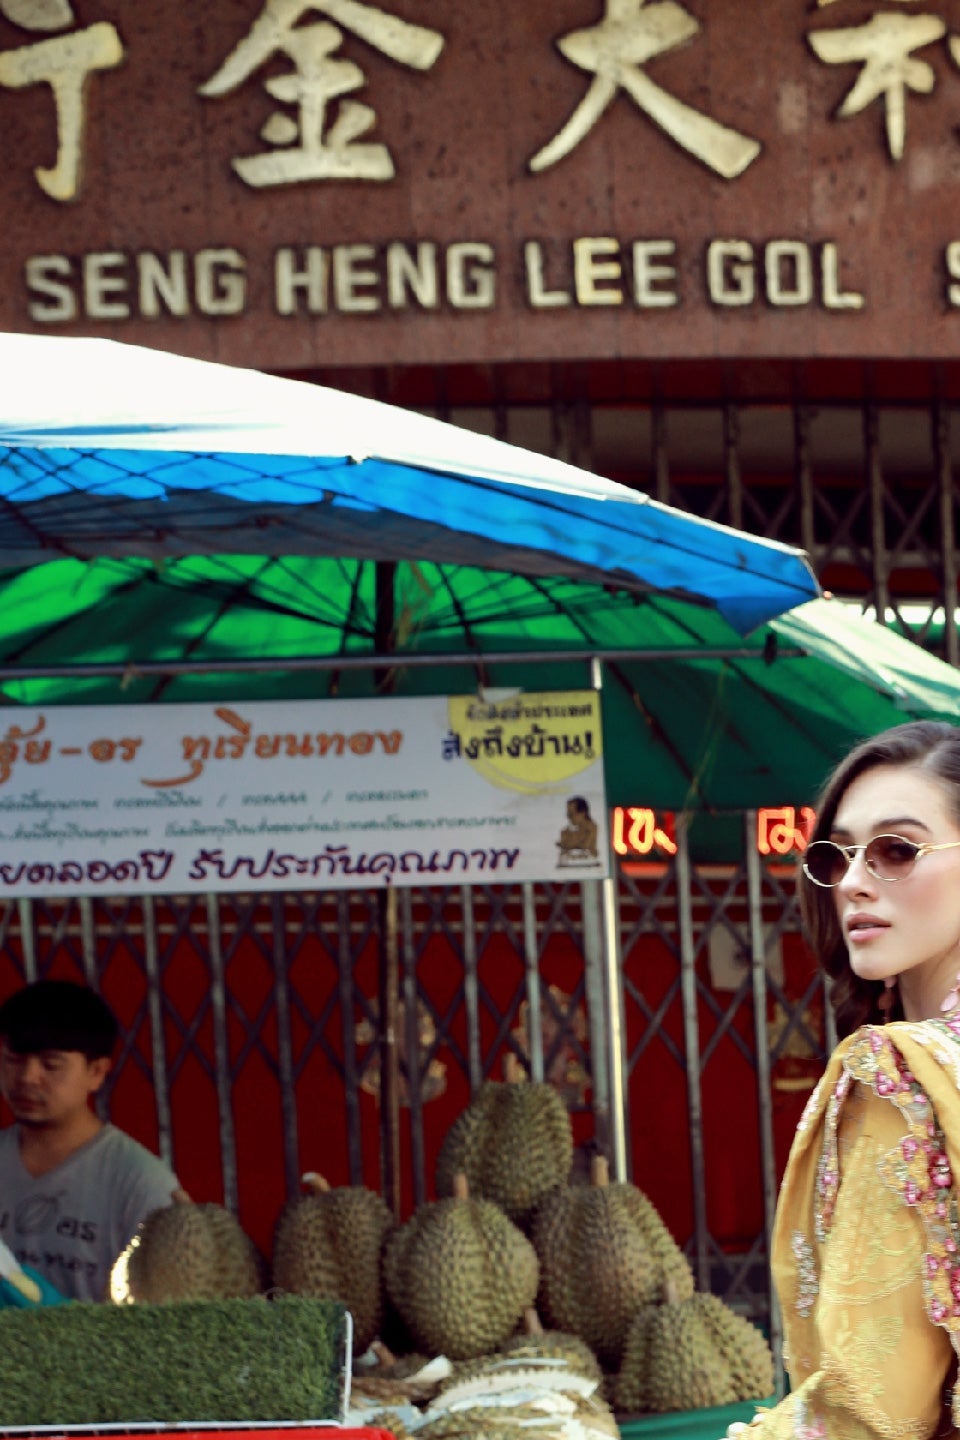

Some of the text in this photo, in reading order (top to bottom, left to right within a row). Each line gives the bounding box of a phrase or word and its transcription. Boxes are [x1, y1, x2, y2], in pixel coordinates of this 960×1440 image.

[25, 249, 246, 321] SENG
[276, 243, 495, 316] HENG
[526, 238, 678, 308] LEE
[707, 240, 865, 310] GOL
